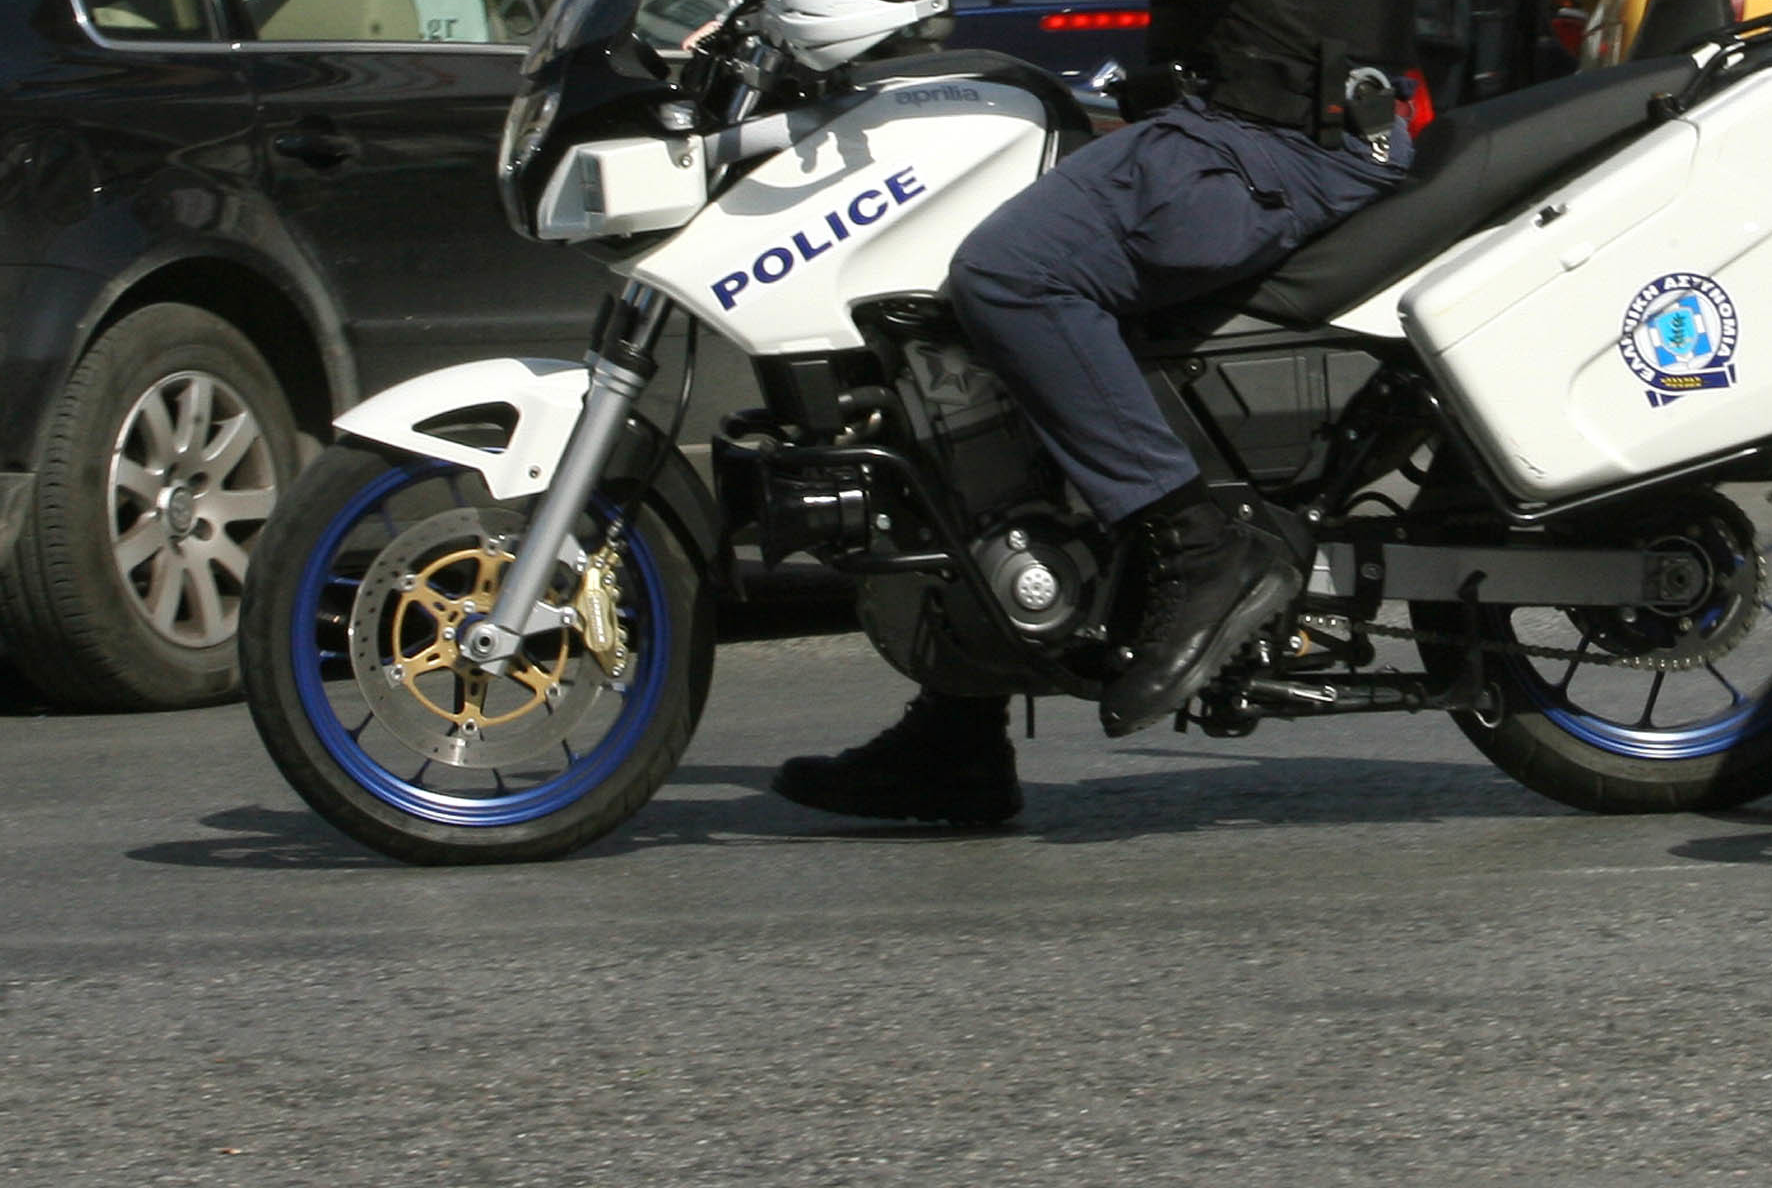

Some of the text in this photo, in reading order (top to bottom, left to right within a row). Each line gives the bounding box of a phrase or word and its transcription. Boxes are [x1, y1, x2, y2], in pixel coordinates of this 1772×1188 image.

[893, 84, 980, 108] aprilia
[710, 166, 927, 312] POLICE
[1663, 274, 1738, 358] ΑΣΤΥΝΟΜΙΑ
